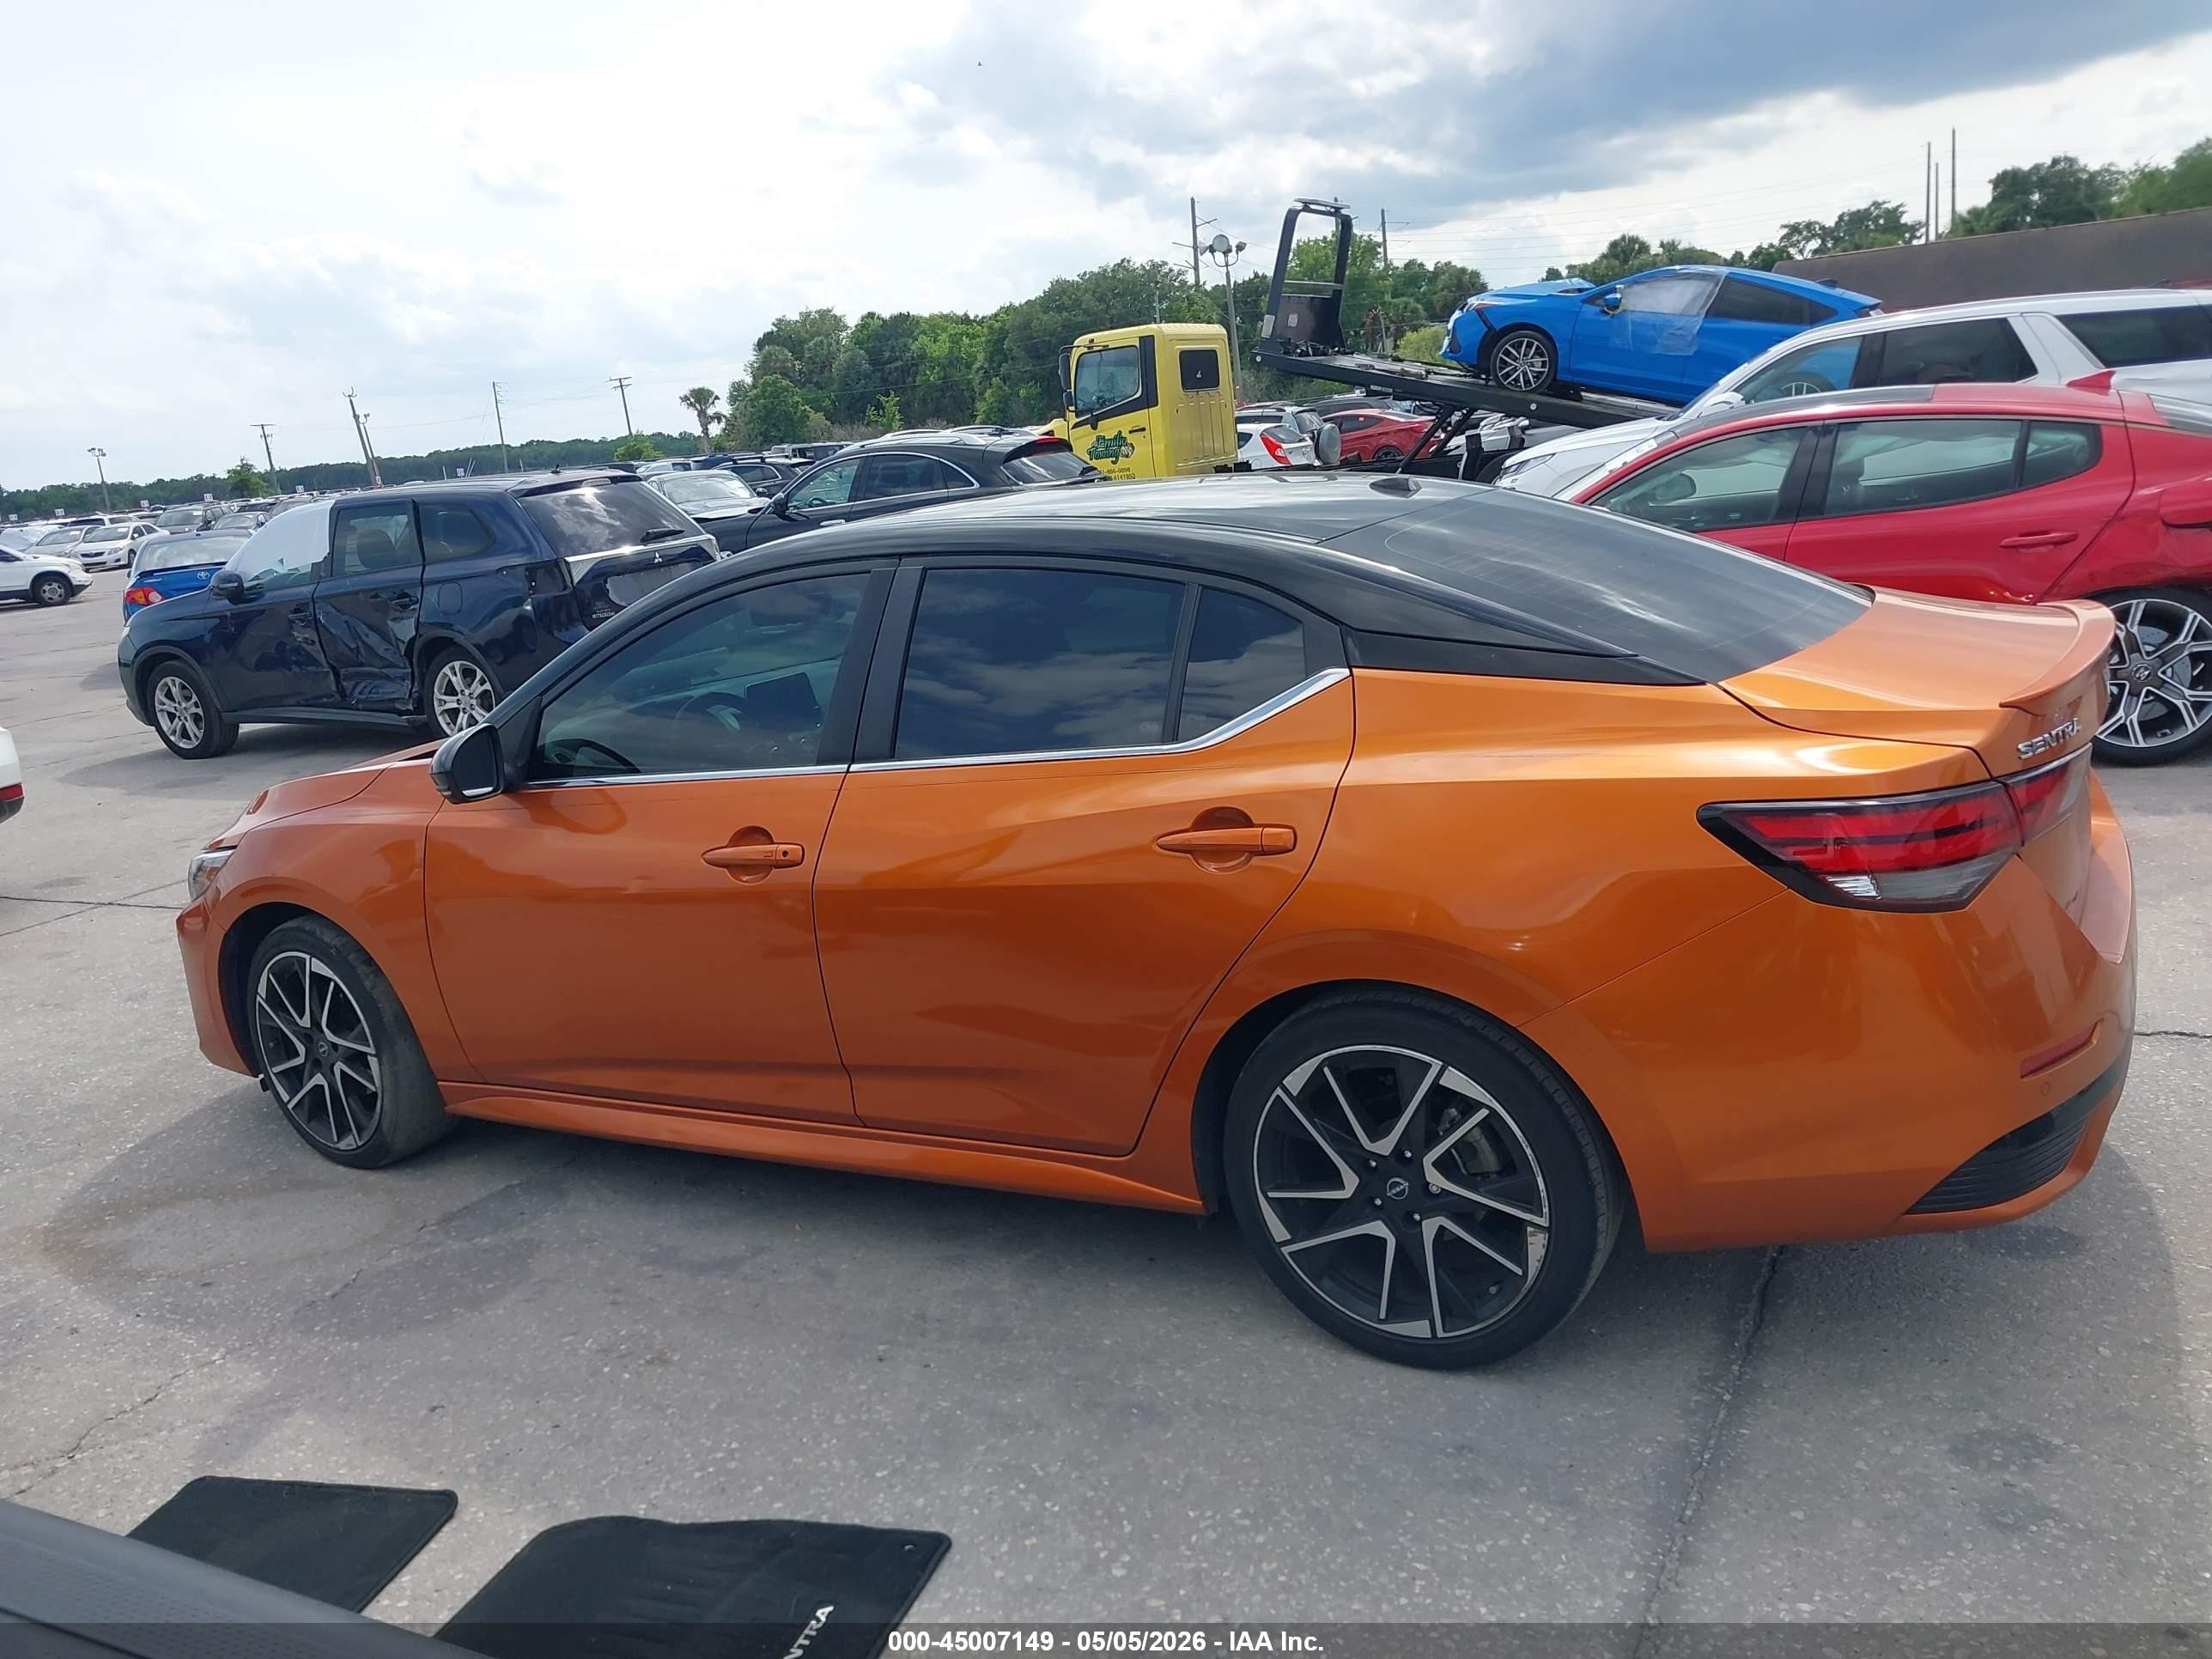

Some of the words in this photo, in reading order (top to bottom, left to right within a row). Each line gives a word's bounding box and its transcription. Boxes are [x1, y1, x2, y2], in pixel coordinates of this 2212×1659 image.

[1095, 430, 1127, 448] Emilio
[1087, 446, 1121, 465] Towing
[2016, 717, 2082, 760] SENTRA
